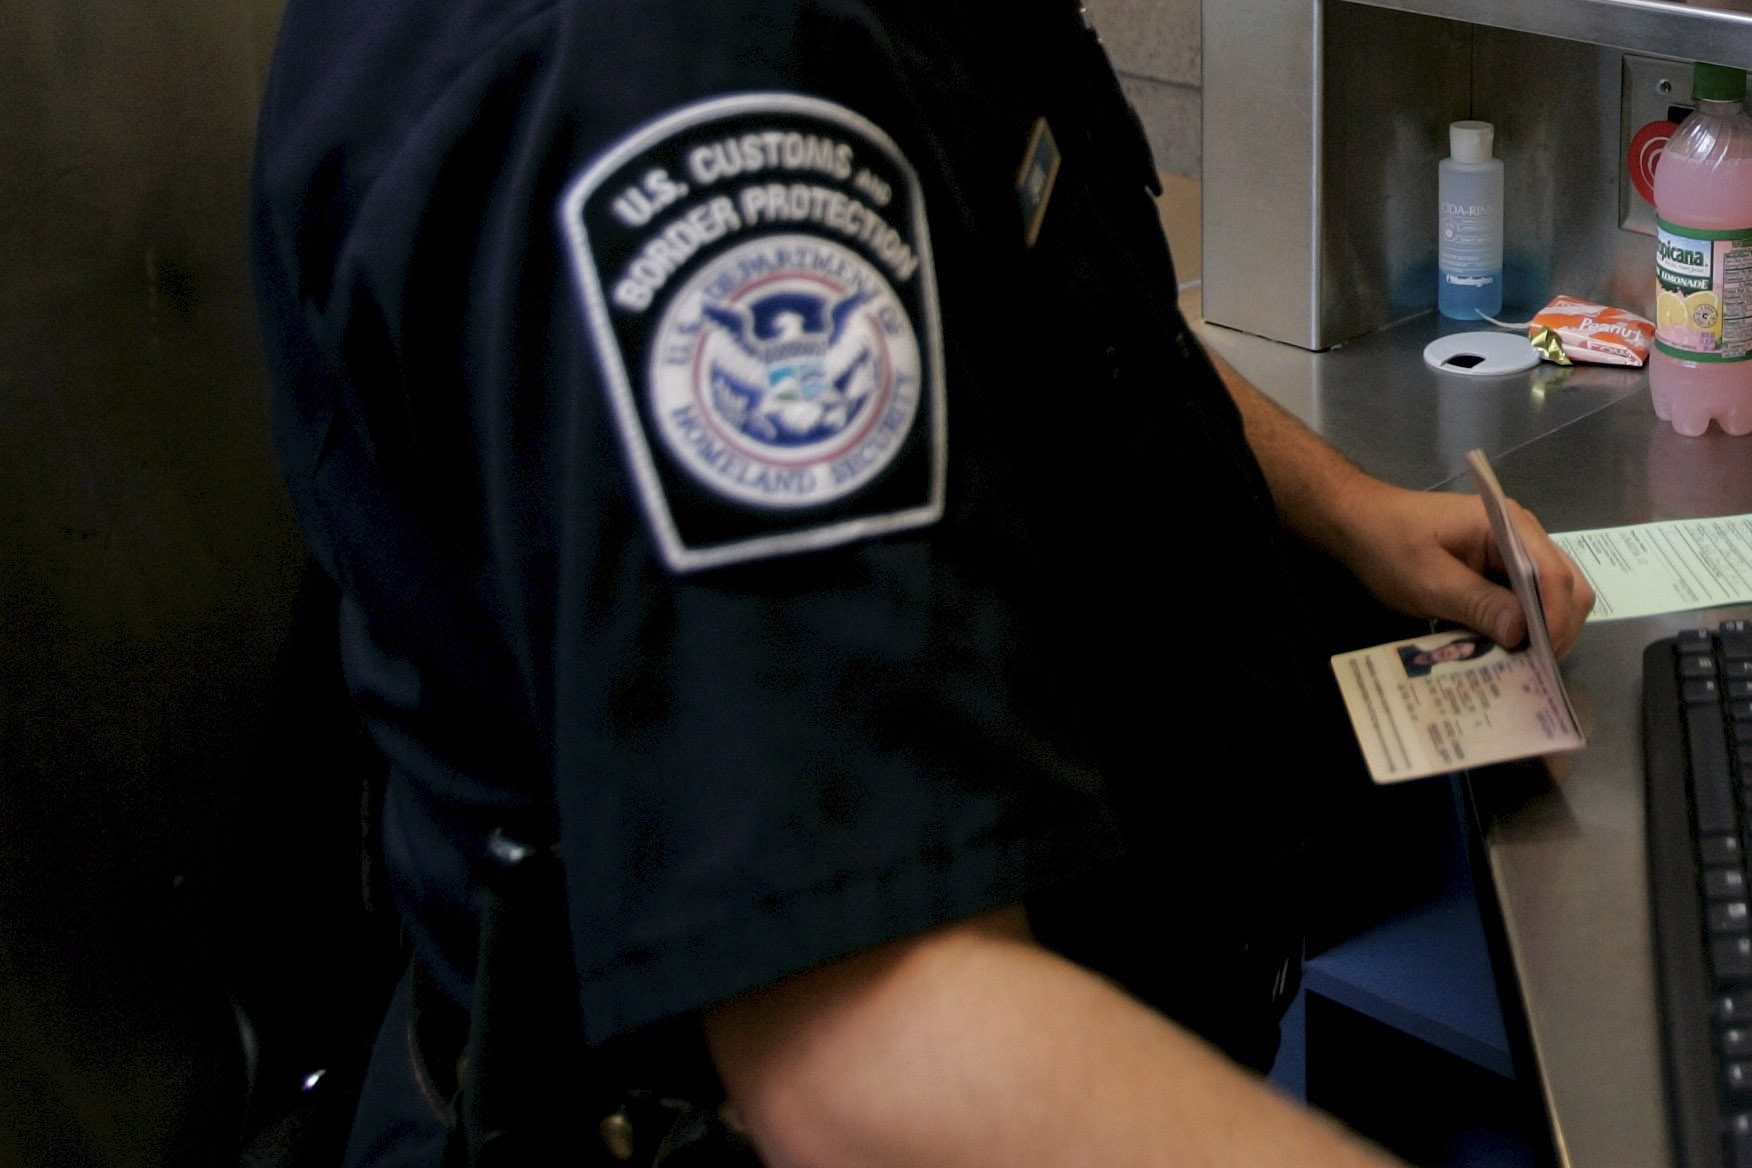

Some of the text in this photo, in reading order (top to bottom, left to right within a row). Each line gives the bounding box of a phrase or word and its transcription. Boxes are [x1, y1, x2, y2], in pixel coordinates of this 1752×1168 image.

[613, 132, 892, 228] U.S. CUSTOMS AND
[613, 183, 920, 313] BORDER PROTECTION
[1661, 270, 1710, 289] LEMONADE
[1580, 317, 1643, 343] Peanut
